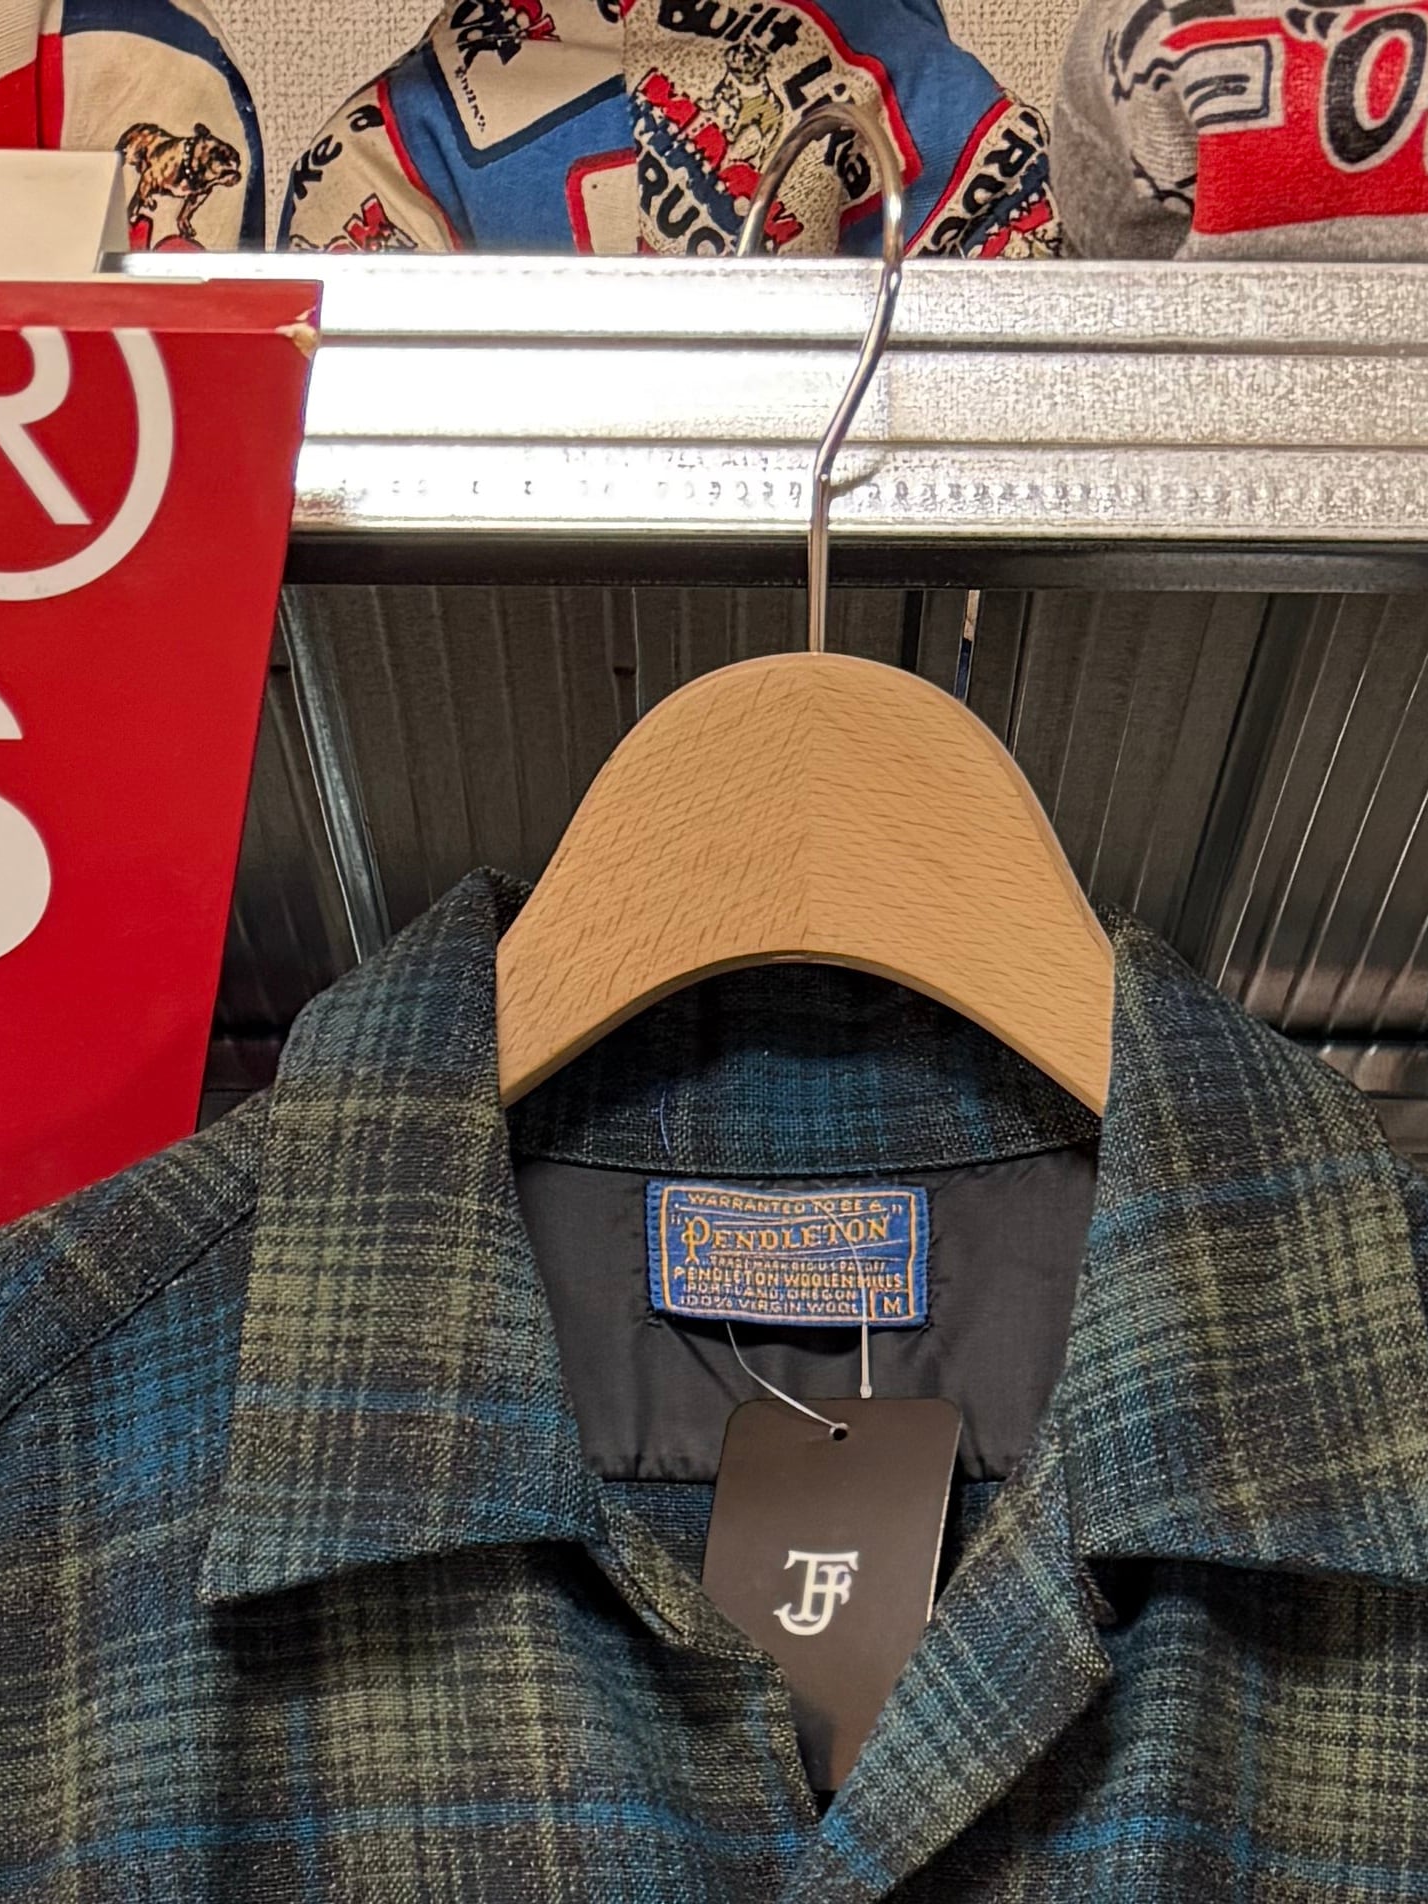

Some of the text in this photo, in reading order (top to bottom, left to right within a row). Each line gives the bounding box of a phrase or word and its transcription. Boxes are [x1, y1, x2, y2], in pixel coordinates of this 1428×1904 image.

[688, 1193, 805, 1215] WARRANTED
[813, 1200, 835, 1213] TO
[840, 1200, 863, 1212] BE
[673, 1266, 903, 1288] PENDLETON WOOLEN MILLS
[684, 1281, 857, 1301] PORTLAND, OREGON
[680, 1295, 859, 1314] 100% VIRGIN WOOL
[883, 1296, 902, 1315] M
